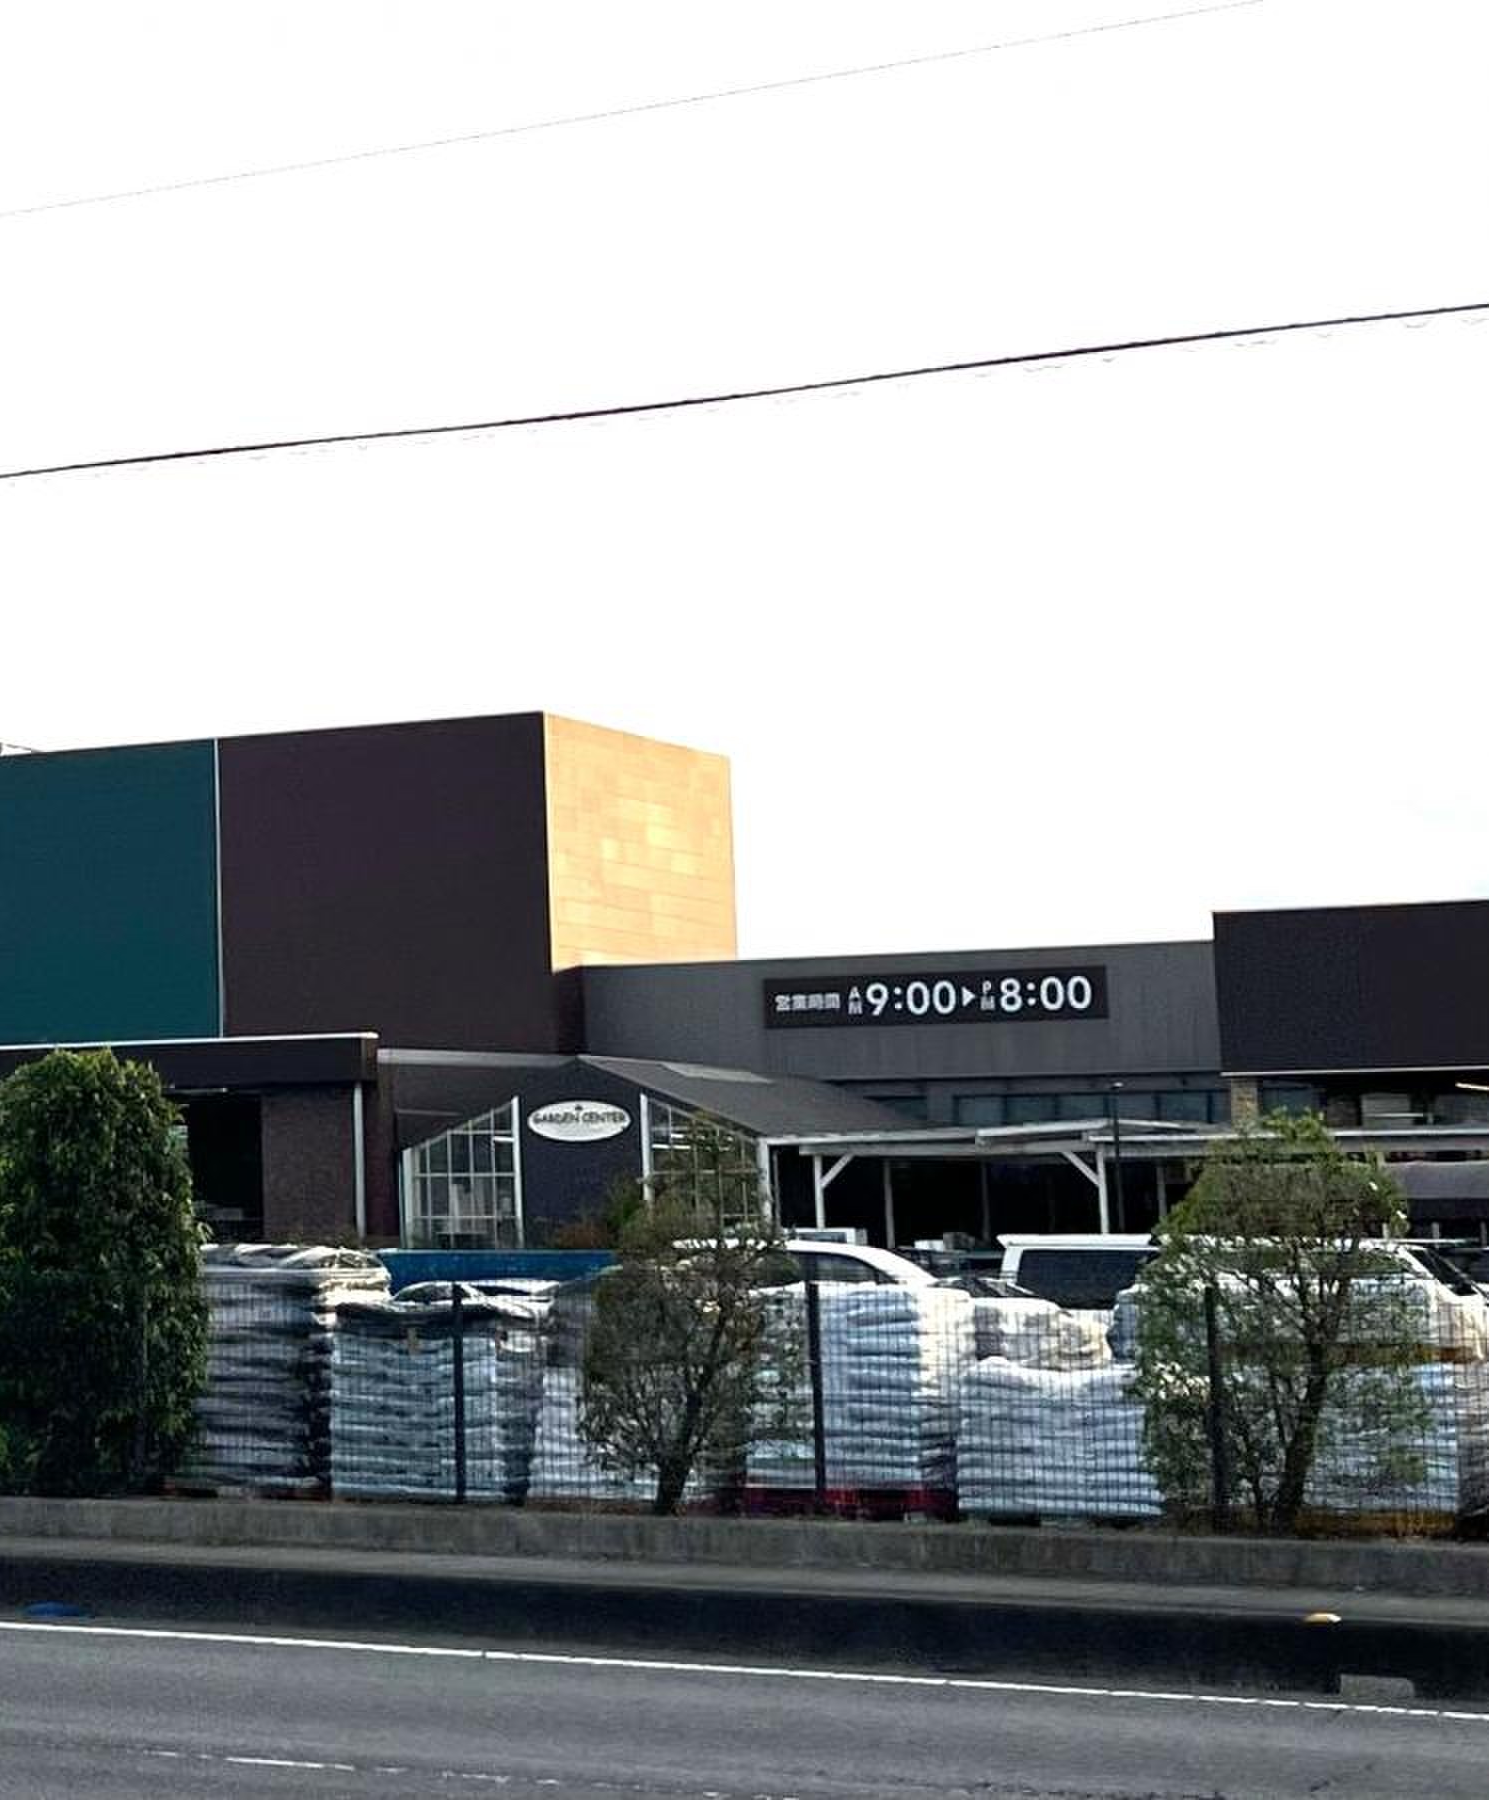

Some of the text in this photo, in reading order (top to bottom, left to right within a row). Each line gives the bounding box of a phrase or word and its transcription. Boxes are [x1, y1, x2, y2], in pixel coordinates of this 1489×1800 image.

[866, 981, 957, 1016] 9:00
[1000, 976, 1092, 1012] 8:00
[582, 1112, 626, 1123] CENTER
